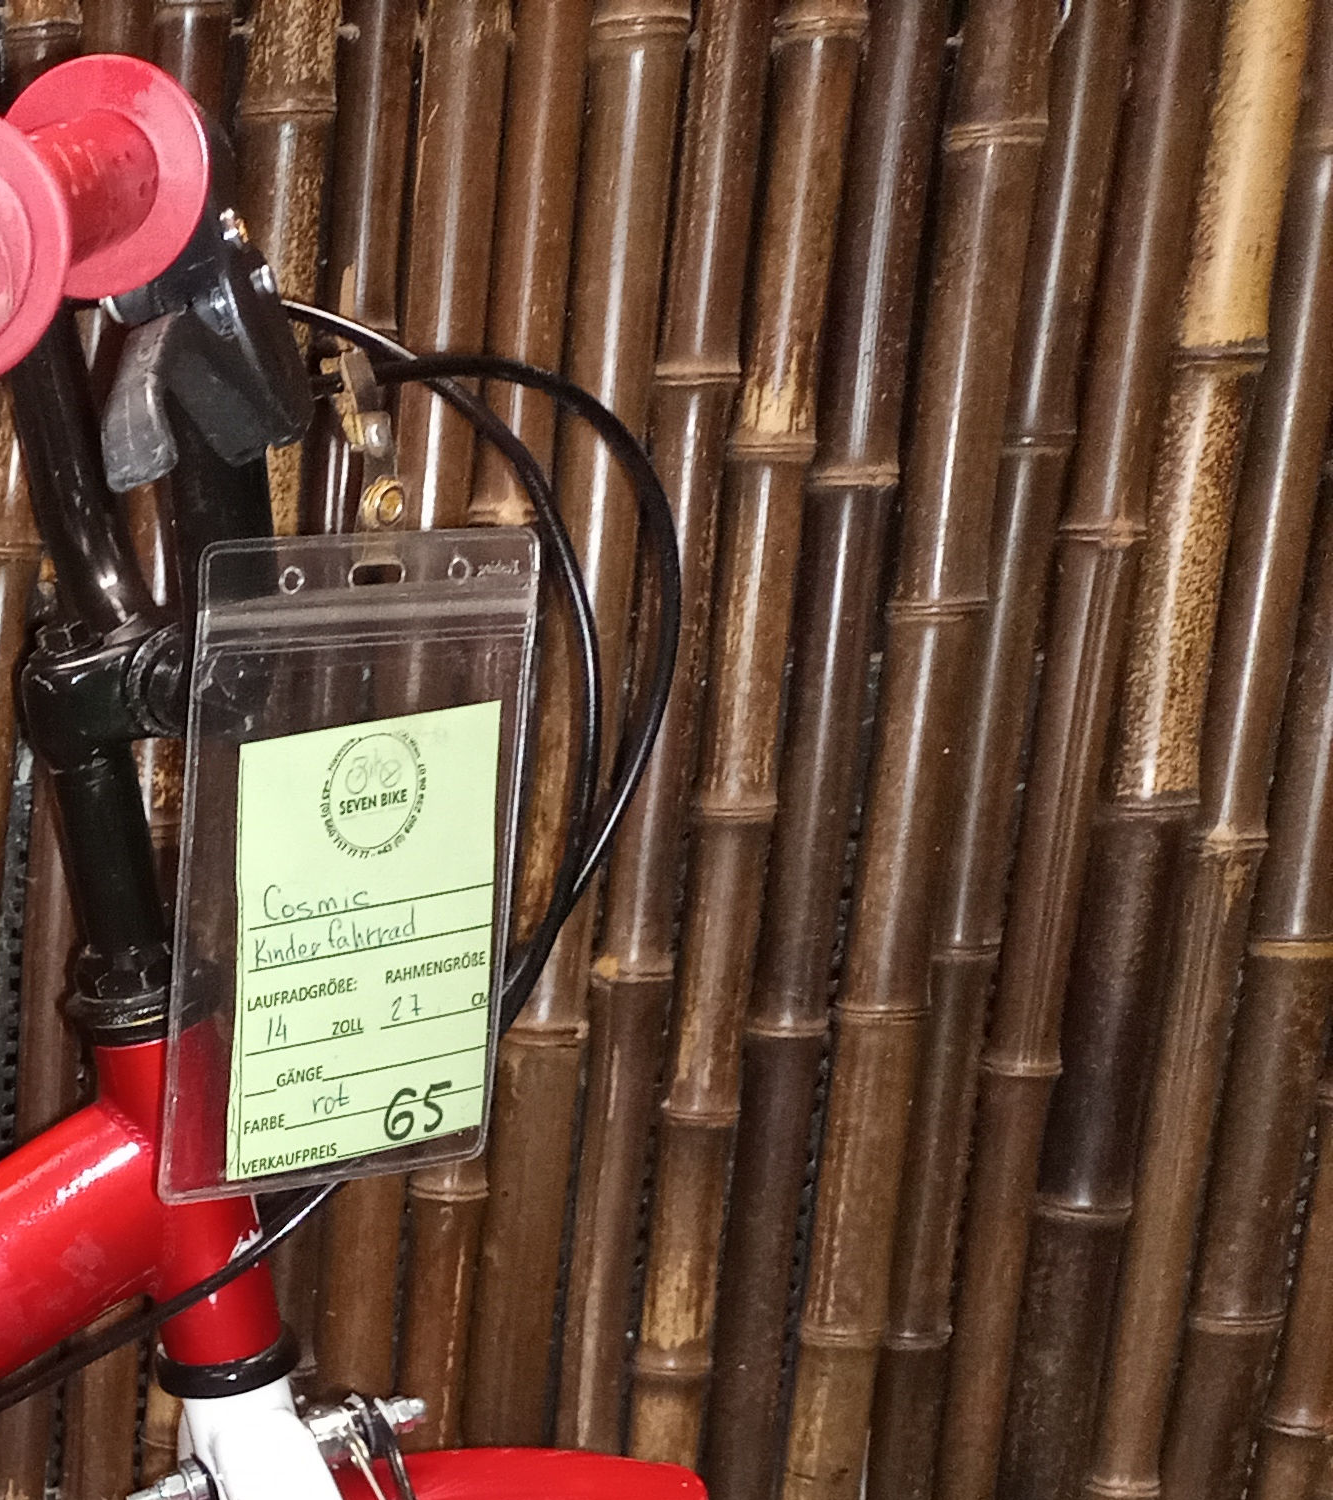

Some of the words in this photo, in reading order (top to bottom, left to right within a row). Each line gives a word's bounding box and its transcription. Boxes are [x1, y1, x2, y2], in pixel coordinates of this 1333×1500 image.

[339, 794, 377, 816] SEVEN
[380, 788, 408, 807] BIKE
[263, 884, 370, 921] Cosmic
[390, 993, 423, 1022] 27
[266, 1014, 288, 1046] 14
[332, 1018, 365, 1036] ZOLL
[276, 1065, 324, 1088] GÄNGE
[312, 1082, 351, 1115] rot
[383, 1079, 453, 1142] 65
[243, 1114, 286, 1135] FARBE
[241, 1142, 338, 1175] VERKAUFPREIS
